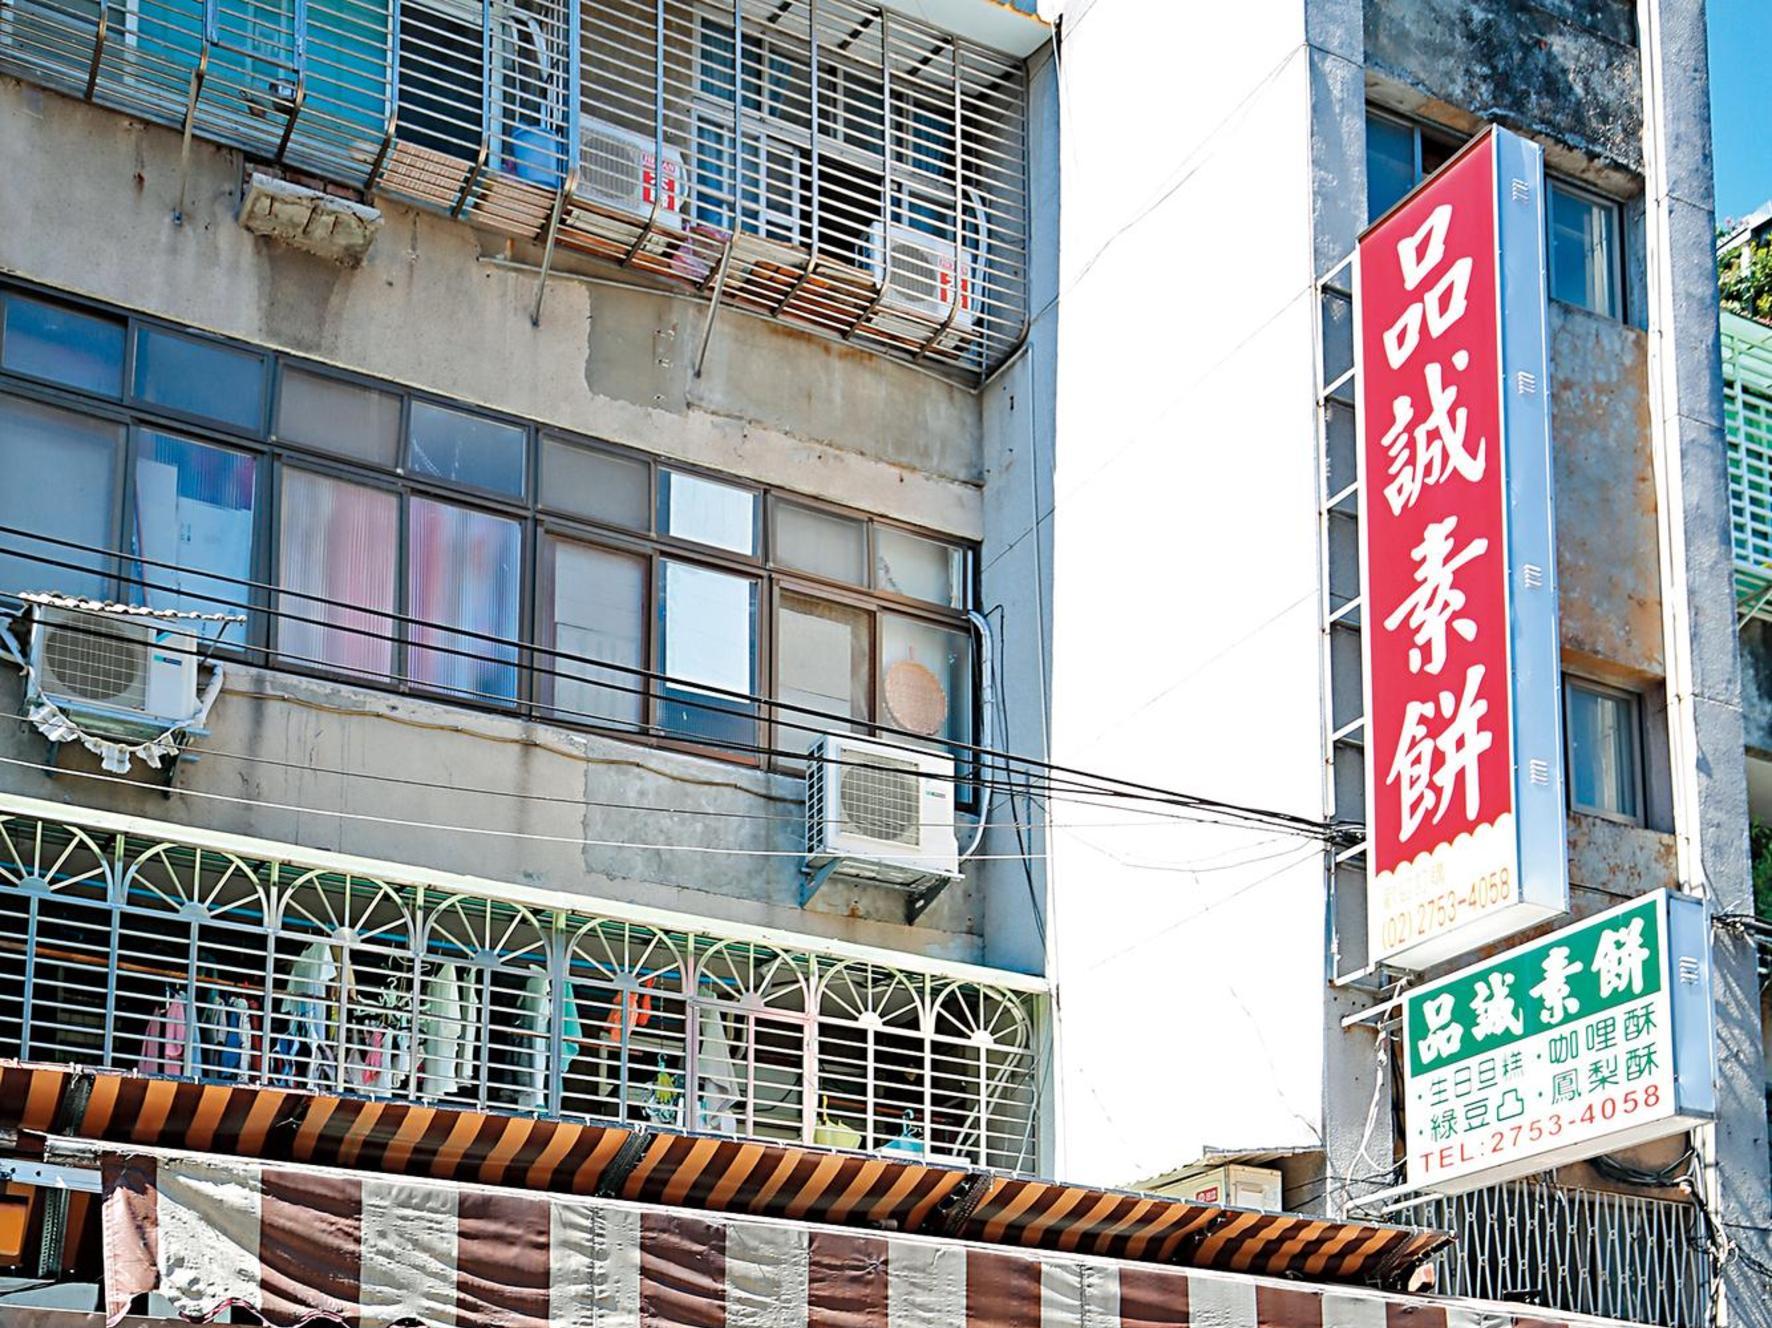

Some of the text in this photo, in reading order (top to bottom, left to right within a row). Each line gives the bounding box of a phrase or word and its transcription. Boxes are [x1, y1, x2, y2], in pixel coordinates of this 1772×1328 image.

[1381, 202, 1493, 843] 品誠素餅
[1418, 917, 1650, 1065] 品誠素餅
[1419, 1084, 1661, 1174] TEL:2753-4058
